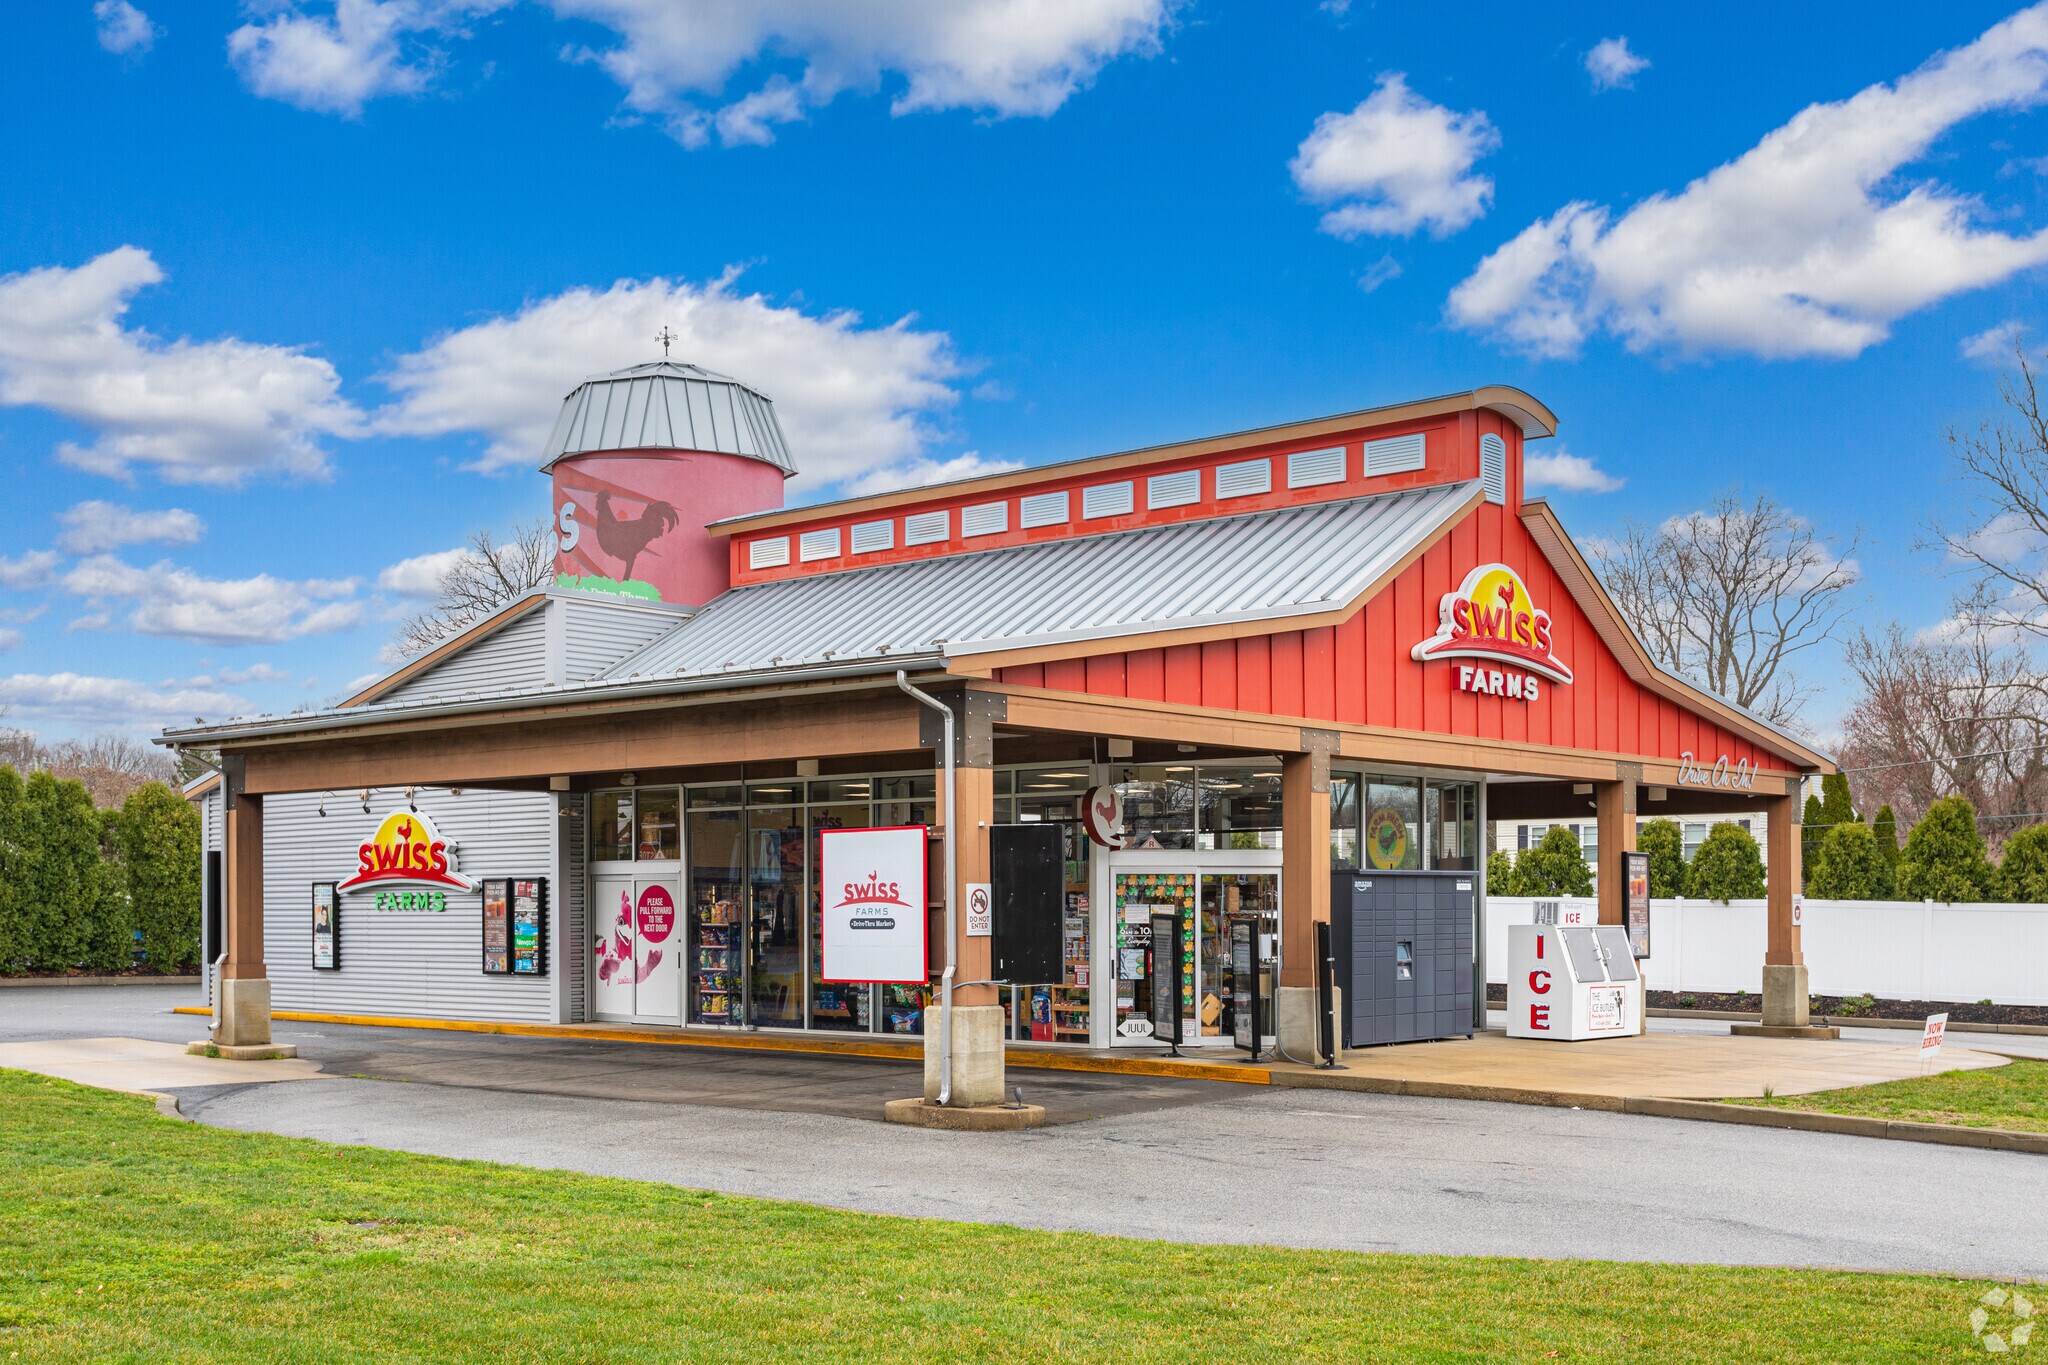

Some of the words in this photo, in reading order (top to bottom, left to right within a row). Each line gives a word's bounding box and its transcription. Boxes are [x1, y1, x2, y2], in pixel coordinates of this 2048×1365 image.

[1451, 598, 1551, 652] SWISS
[1459, 665, 1539, 701] FARMS
[1678, 751, 1709, 784] Drive
[1711, 754, 1729, 787] On
[1732, 757, 1758, 790] In!
[358, 841, 448, 875] SWISS
[844, 882, 900, 901] SWISS
[375, 892, 446, 912] FARMS
[647, 898, 663, 906] PLEASE
[640, 906, 650, 914] PULL
[650, 906, 672, 914] FORWARD
[855, 907, 889, 916] FARMS
[648, 915, 655, 923] TO
[655, 915, 663, 923] THE
[1565, 912, 1581, 924] ICE
[644, 924, 655, 932] NEXT
[655, 924, 668, 932] DOOR
[1127, 1023, 1147, 1033] JUUL
[1927, 1022, 1943, 1035] NOW
[1921, 1035, 1943, 1049] HIRING
